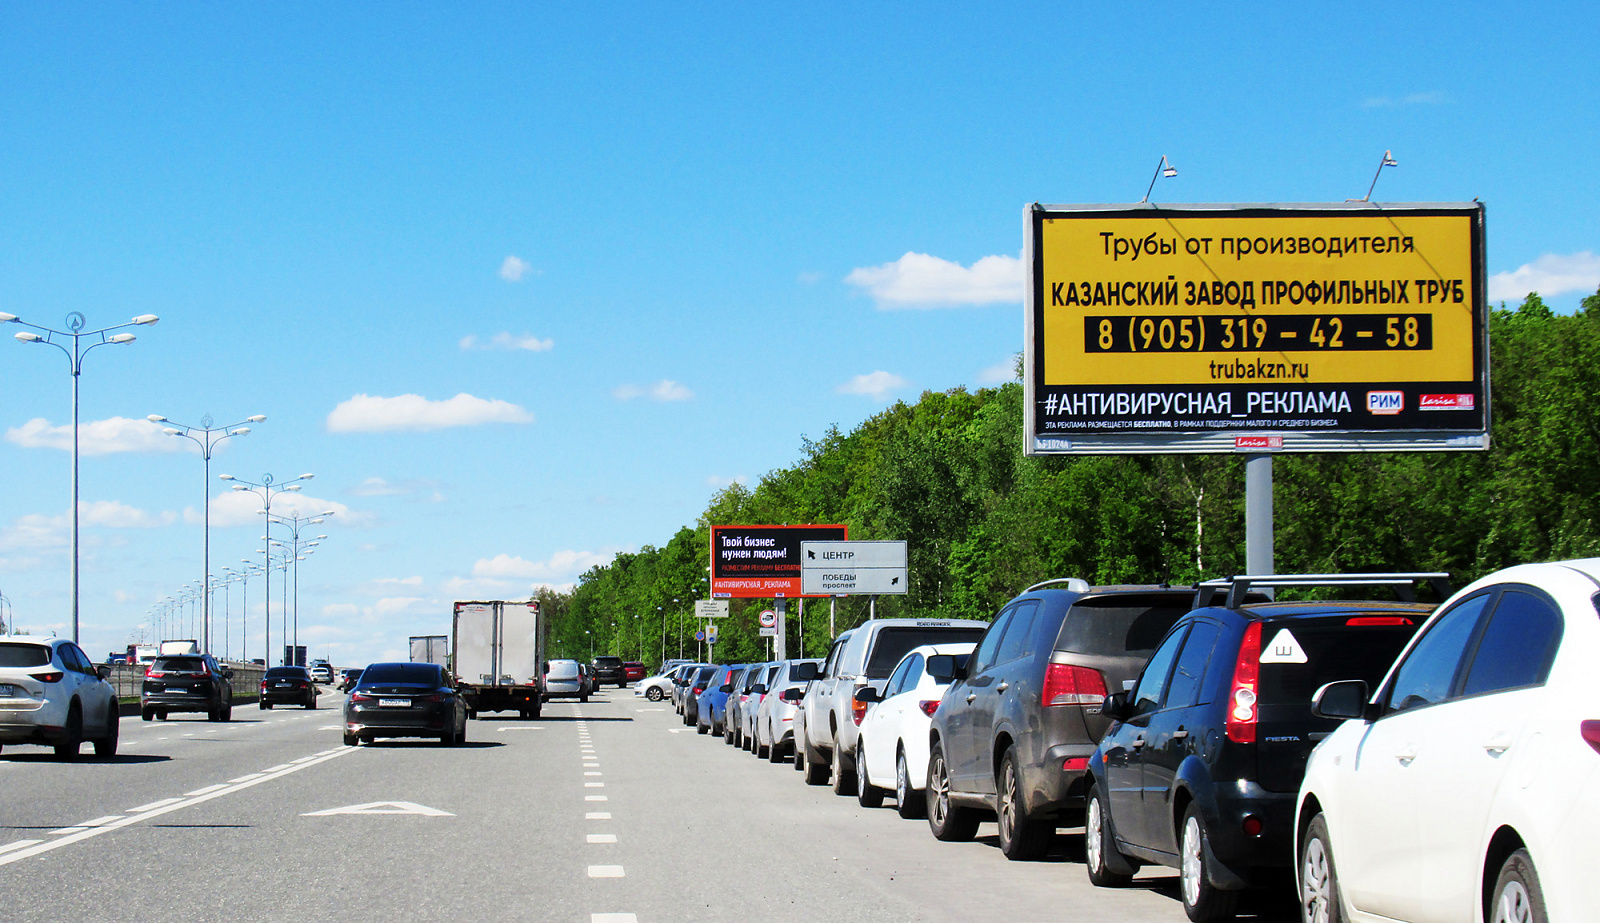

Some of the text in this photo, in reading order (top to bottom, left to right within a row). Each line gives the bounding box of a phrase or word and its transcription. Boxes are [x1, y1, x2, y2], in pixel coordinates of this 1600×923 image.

[1099, 232, 1415, 261] Трубы от производителя
[1051, 275, 1465, 309] КАЗАНСКИЙ ЗАВОД ПРОФИЛЬНЫХ ТРУБ
[1098, 318, 1113, 350] 8
[1128, 316, 1206, 352] (905)
[1220, 318, 1268, 349] 319
[1309, 317, 1344, 348] 42
[1385, 316, 1419, 348] 58
[1209, 357, 1309, 379] trubakzn.ru
[1045, 390, 1352, 418] #АНТИВИРУСНАЯ_РЕКЛАМА
[1370, 394, 1400, 408] РИМ
[1045, 419, 1338, 429] ЭТА РЕКЛАМА РАЗМЕЩАЕТСЯ БЕСПЛАТНО, В РАМКАХ ПОДДЕРЖКИ МАЛОГО И СРЕДНЕГО БИЗНЕСА
[721, 535, 776, 547] Твой бизнес
[722, 547, 787, 561] нужен людям!
[822, 551, 855, 560] ЦЕНТР
[714, 580, 791, 590] #АНТИВИРУСНАЯ_РЕКЛАМА
